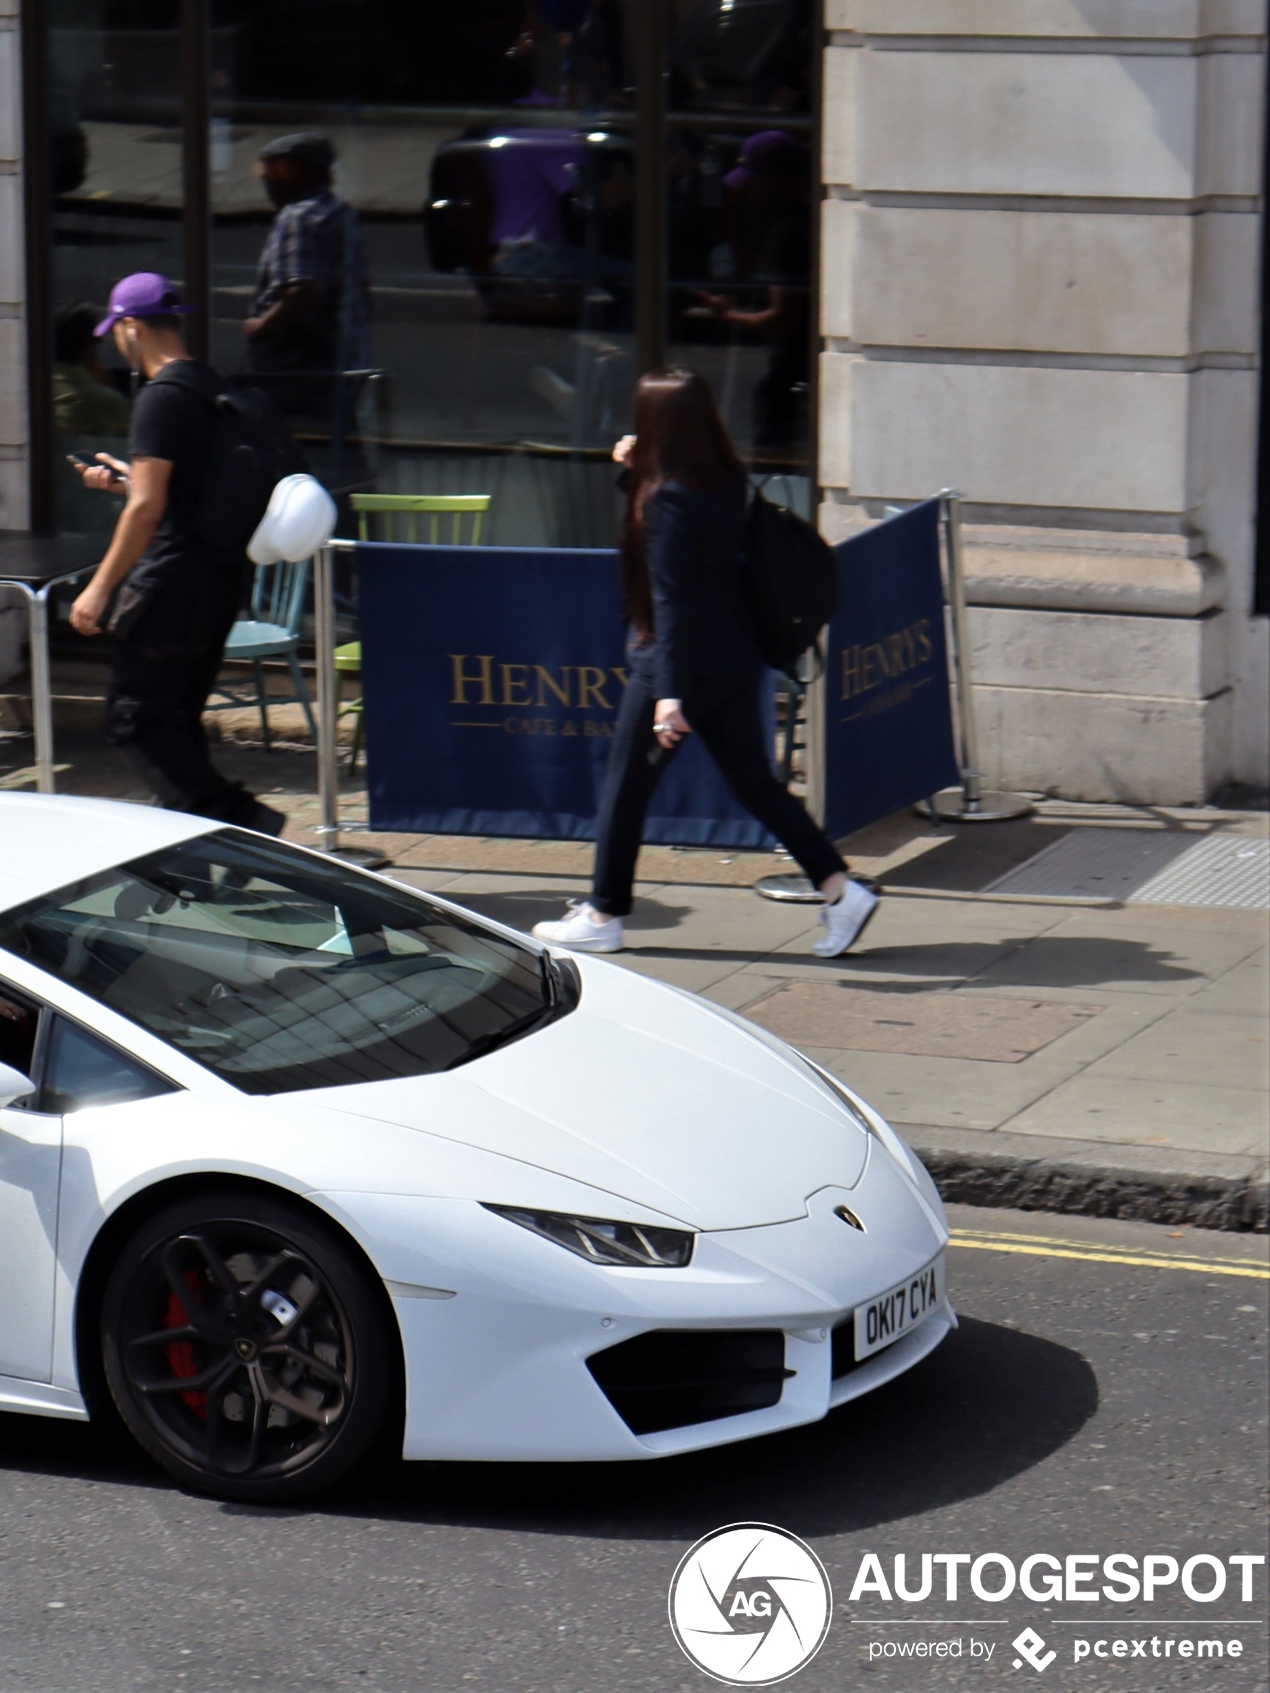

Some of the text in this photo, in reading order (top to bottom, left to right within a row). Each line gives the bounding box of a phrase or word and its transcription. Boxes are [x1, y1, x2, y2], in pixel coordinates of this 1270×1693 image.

[839, 619, 933, 700] HENRYS
[502, 717, 557, 736] CAFE
[561, 718, 578, 736] &
[866, 1268, 937, 1346] OK17 CYA
